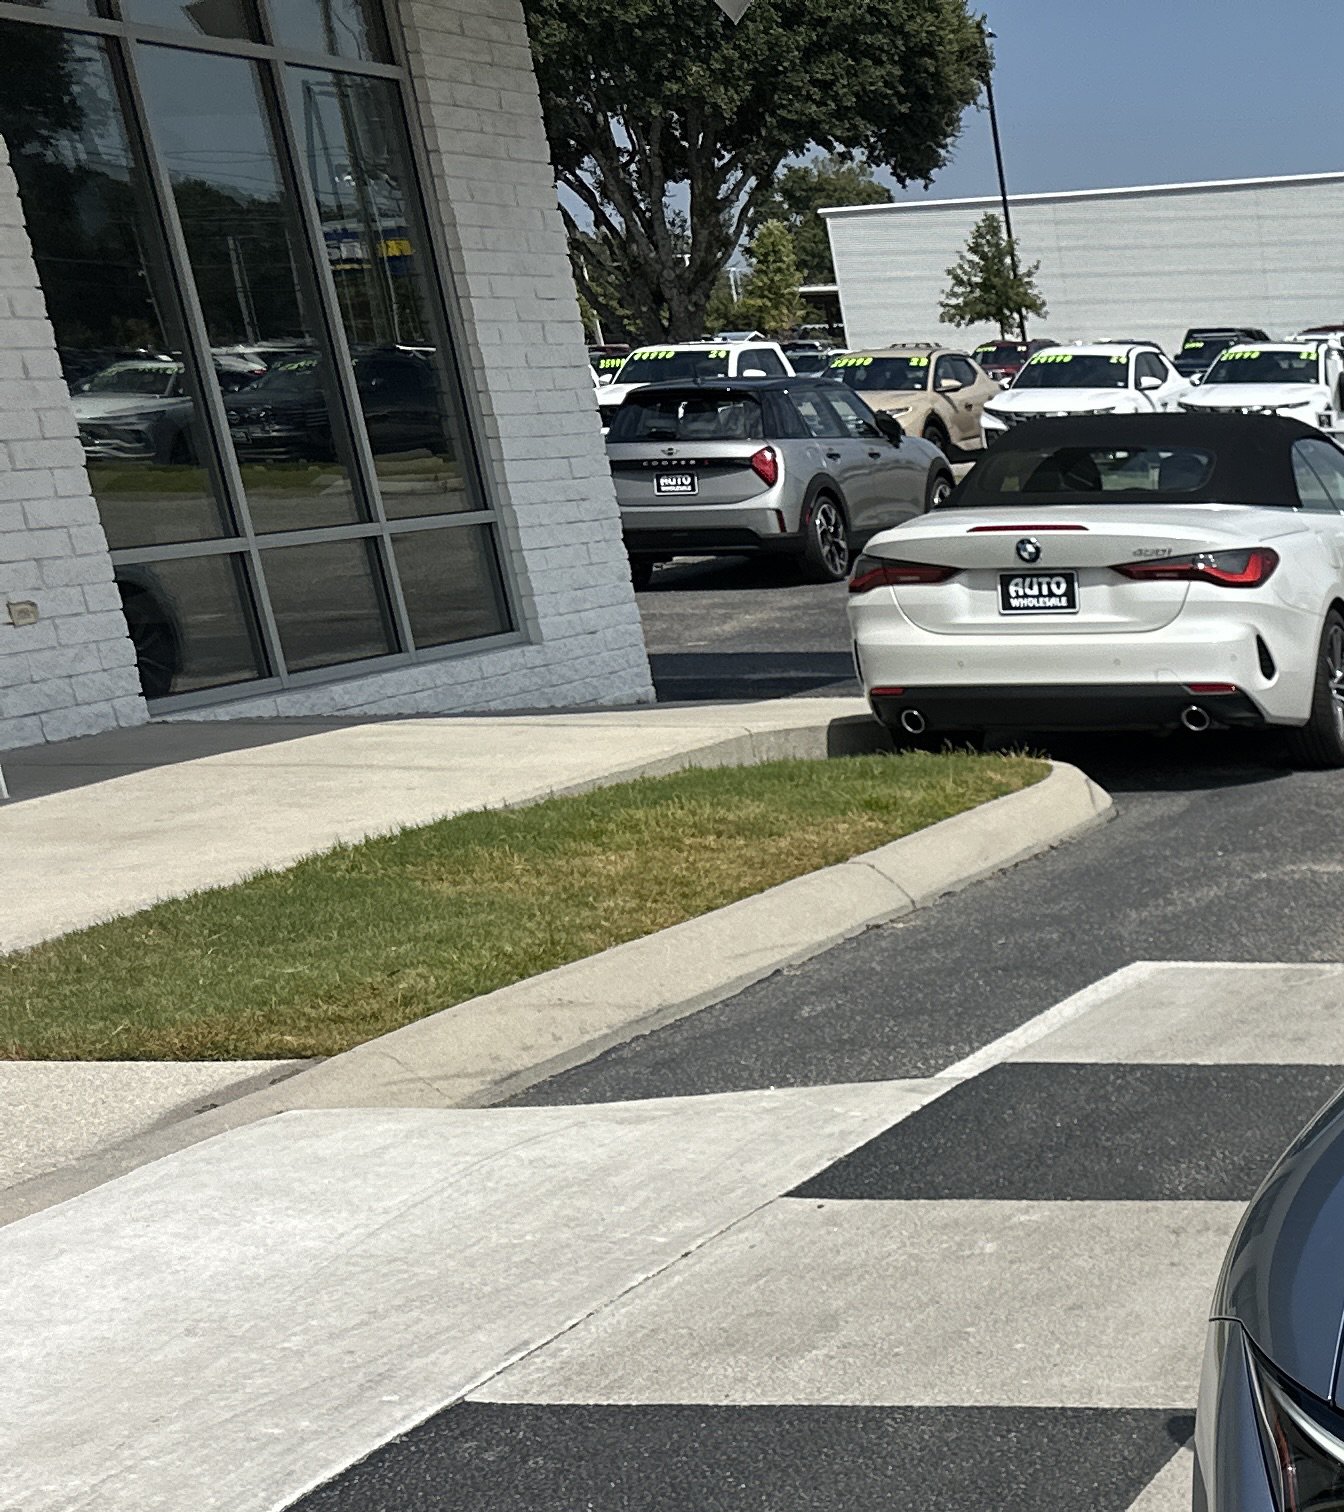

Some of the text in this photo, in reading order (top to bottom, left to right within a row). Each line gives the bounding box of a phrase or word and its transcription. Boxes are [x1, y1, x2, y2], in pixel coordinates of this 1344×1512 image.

[659, 475, 692, 486] AUTO
[1008, 576, 1067, 598] AUTO
[1009, 597, 1068, 608] WHOLESALE
